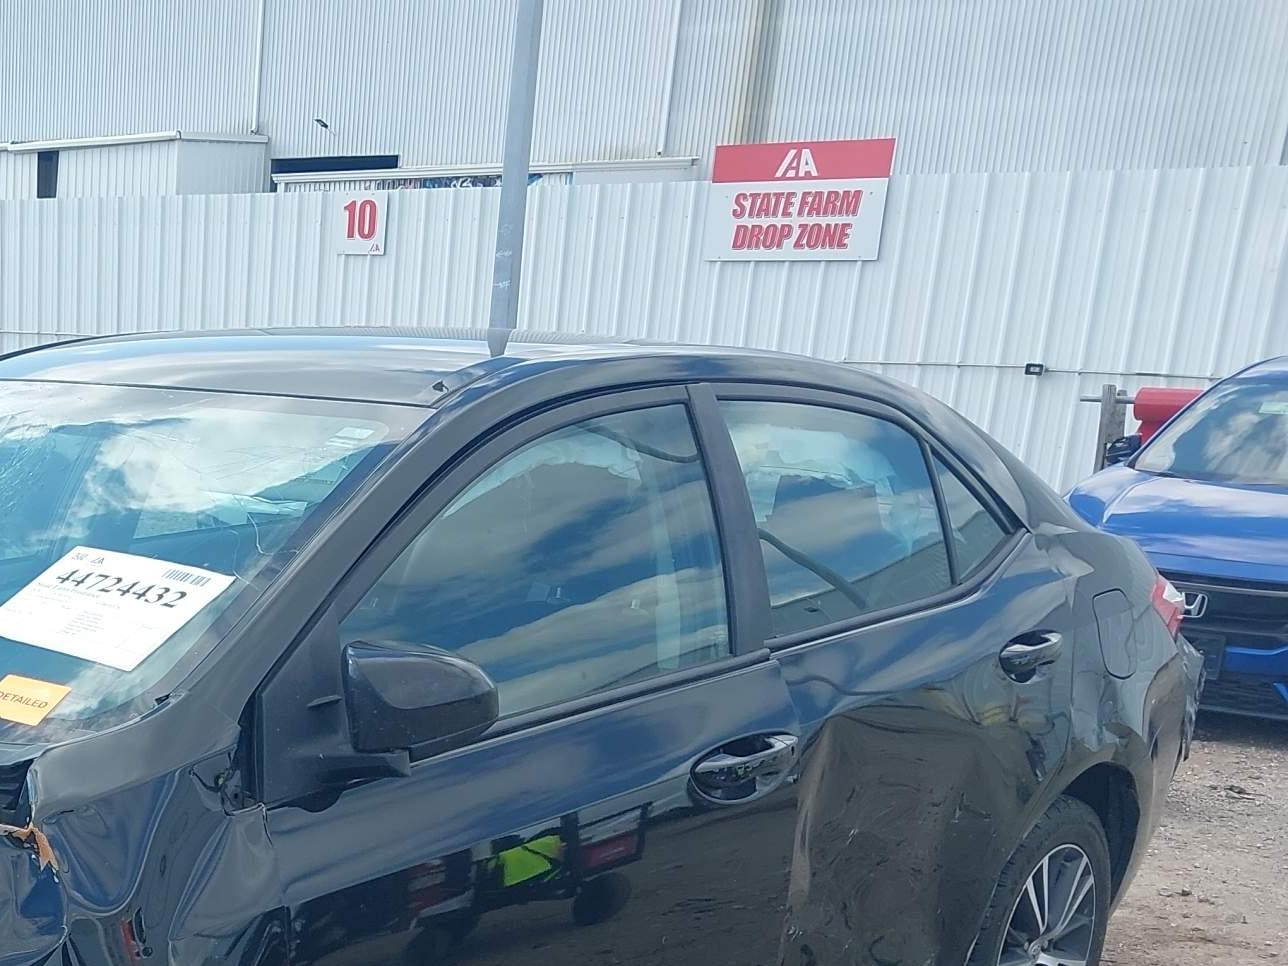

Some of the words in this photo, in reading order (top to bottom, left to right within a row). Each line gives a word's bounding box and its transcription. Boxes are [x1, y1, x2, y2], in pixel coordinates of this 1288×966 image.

[343, 199, 377, 240] 10
[731, 191, 797, 220] STATE
[796, 189, 863, 218] FARM
[731, 224, 794, 251] DROP
[793, 222, 853, 250] ZONE
[56, 569, 187, 608] 44724432
